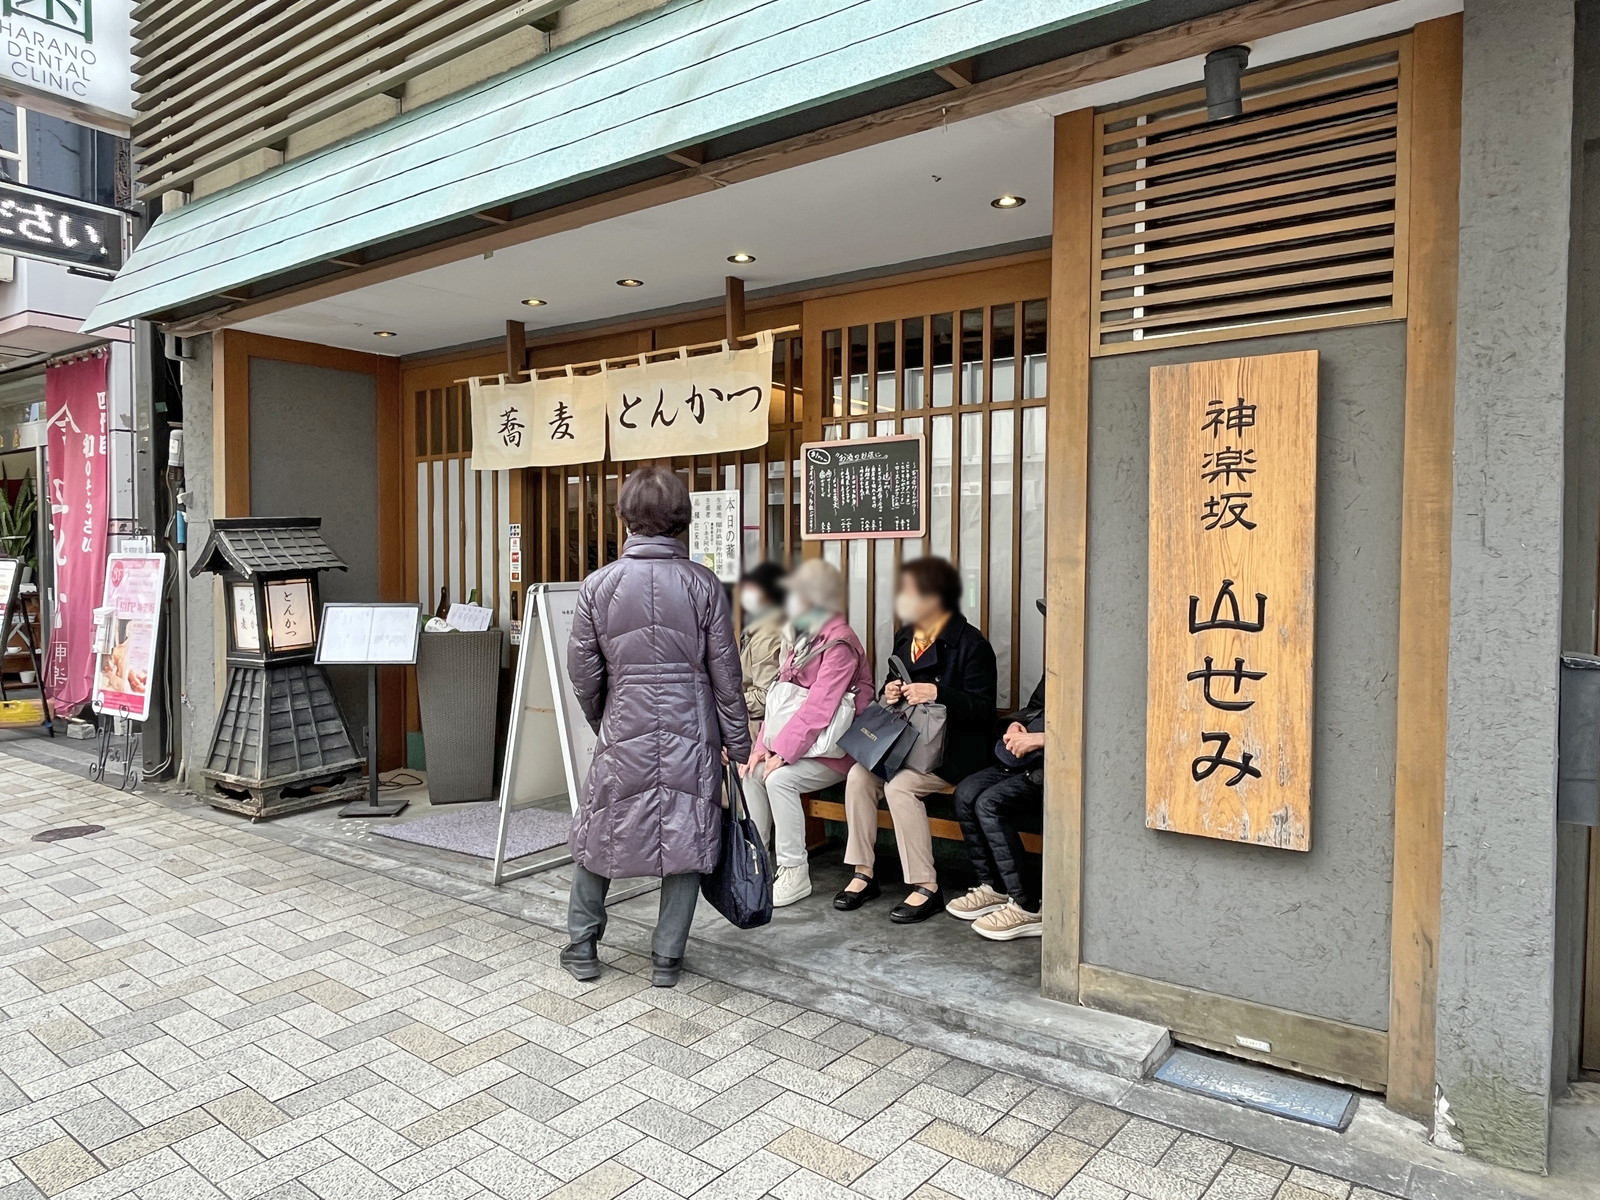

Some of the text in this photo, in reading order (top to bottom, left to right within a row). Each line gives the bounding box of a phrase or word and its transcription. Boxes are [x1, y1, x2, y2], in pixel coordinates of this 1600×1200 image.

[0, 18, 96, 65] HARANO
[7, 40, 91, 82] DENTAL
[11, 61, 87, 97] CLINIC
[497, 383, 763, 448] 蕎麦 とんかつ
[1200, 397, 1258, 531] 神楽坂
[725, 497, 736, 576] 本日の蕎
[283, 591, 297, 637] とんかつ
[1186, 579, 1268, 787] 山せみ
